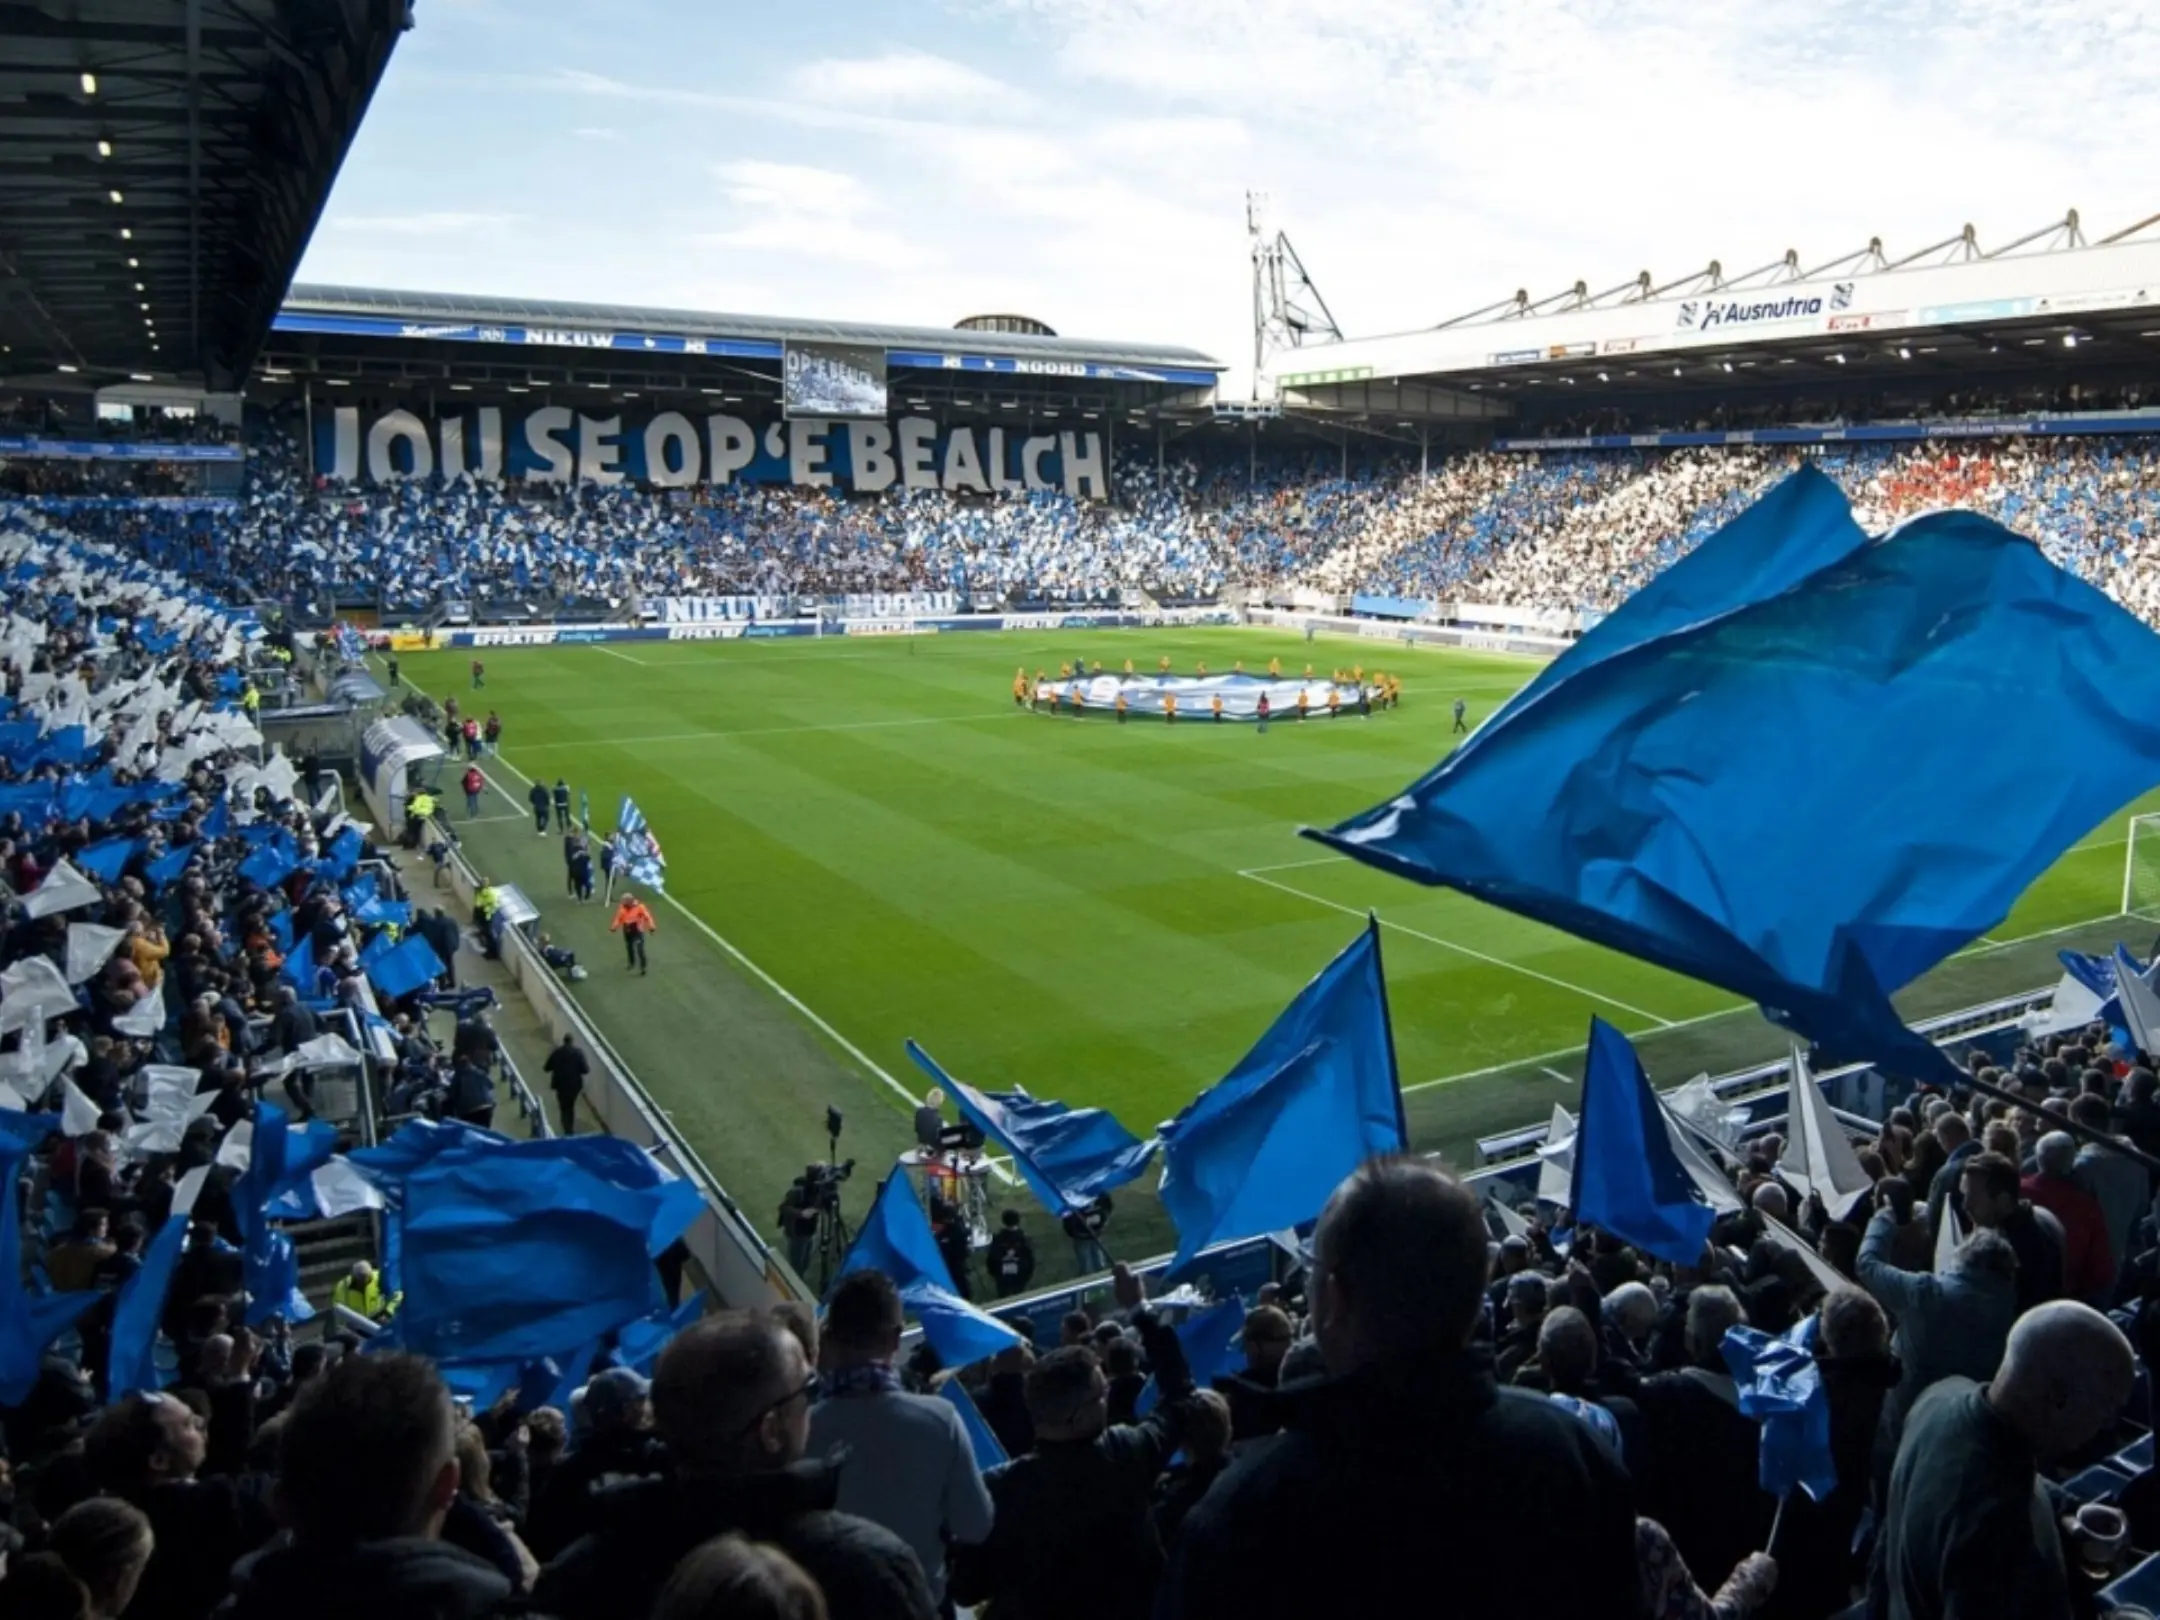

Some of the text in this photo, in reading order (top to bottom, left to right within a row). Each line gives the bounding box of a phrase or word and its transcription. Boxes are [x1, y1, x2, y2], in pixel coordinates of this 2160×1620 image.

[1724, 297, 1822, 322] Ausnutria
[525, 329, 614, 347] NIEUW
[1015, 359, 1086, 376] NOORD
[525, 406, 626, 486] SE
[848, 416, 1108, 502] BEALCH
